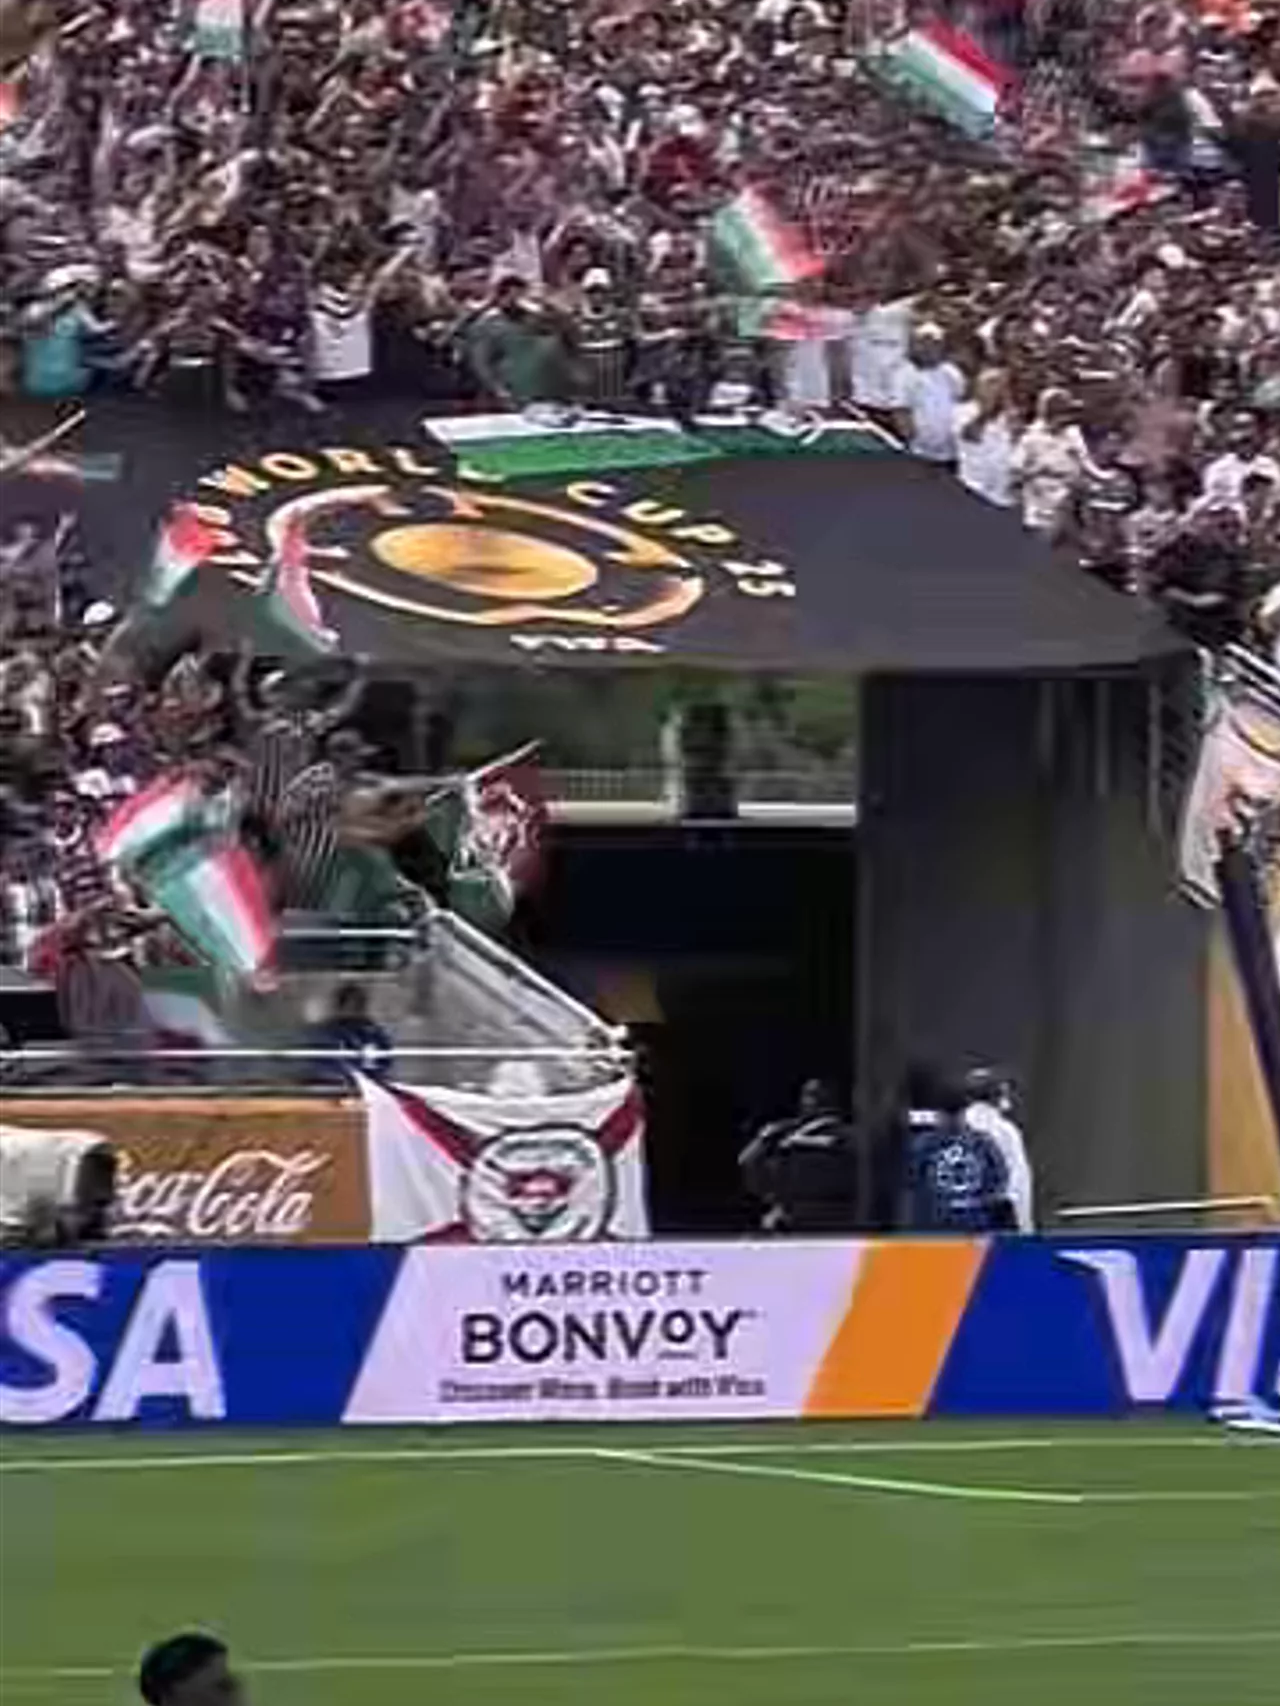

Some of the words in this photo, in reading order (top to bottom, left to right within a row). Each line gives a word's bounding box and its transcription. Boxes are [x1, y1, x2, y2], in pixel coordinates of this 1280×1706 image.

[198, 447, 502, 497] WORL
[566, 482, 735, 547] CUP
[501, 1268, 708, 1298] MARRIOTT
[0, 1259, 227, 1424] SA
